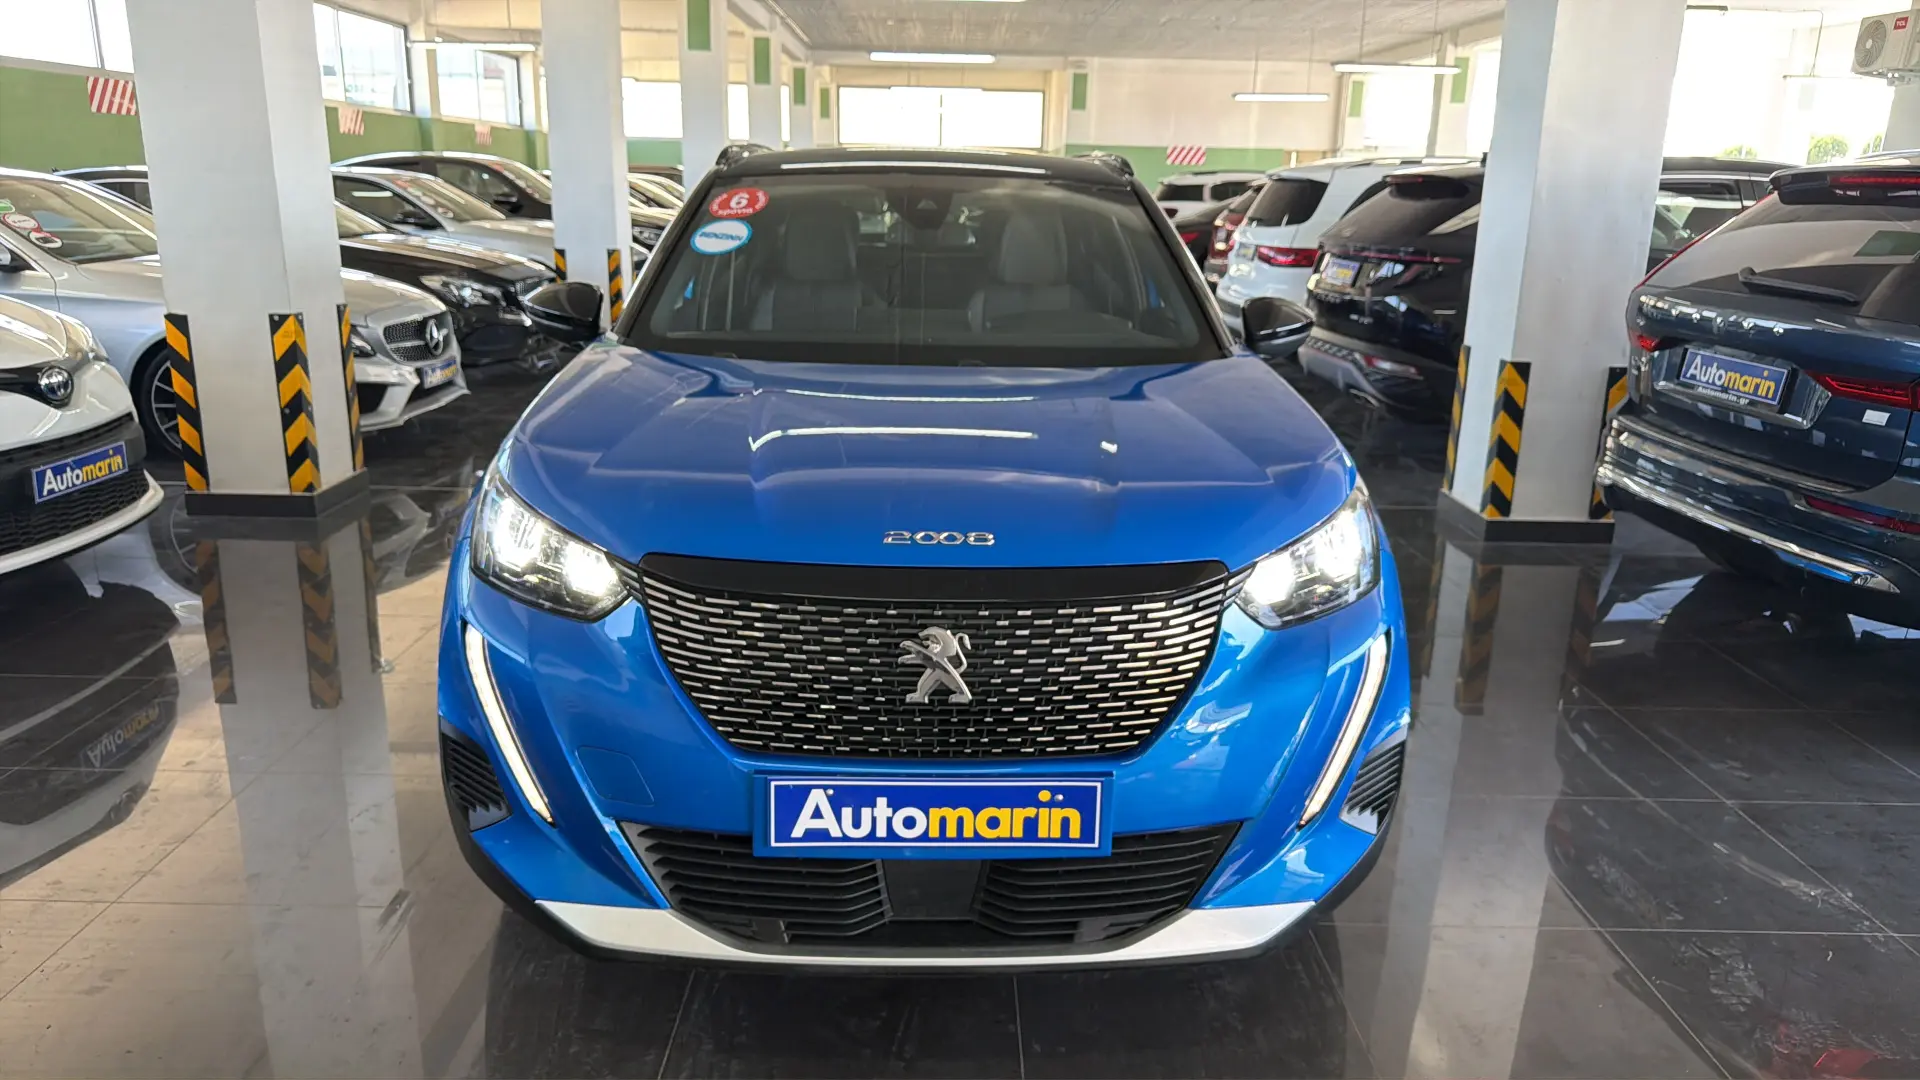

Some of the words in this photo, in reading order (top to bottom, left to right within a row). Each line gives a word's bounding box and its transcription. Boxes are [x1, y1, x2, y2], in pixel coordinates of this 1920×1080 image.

[729, 192, 750, 209] 6
[1686, 354, 1776, 399] Automarin
[42, 448, 123, 496] Automarin
[883, 530, 995, 546] 2008
[790, 788, 1081, 839] Automarin
